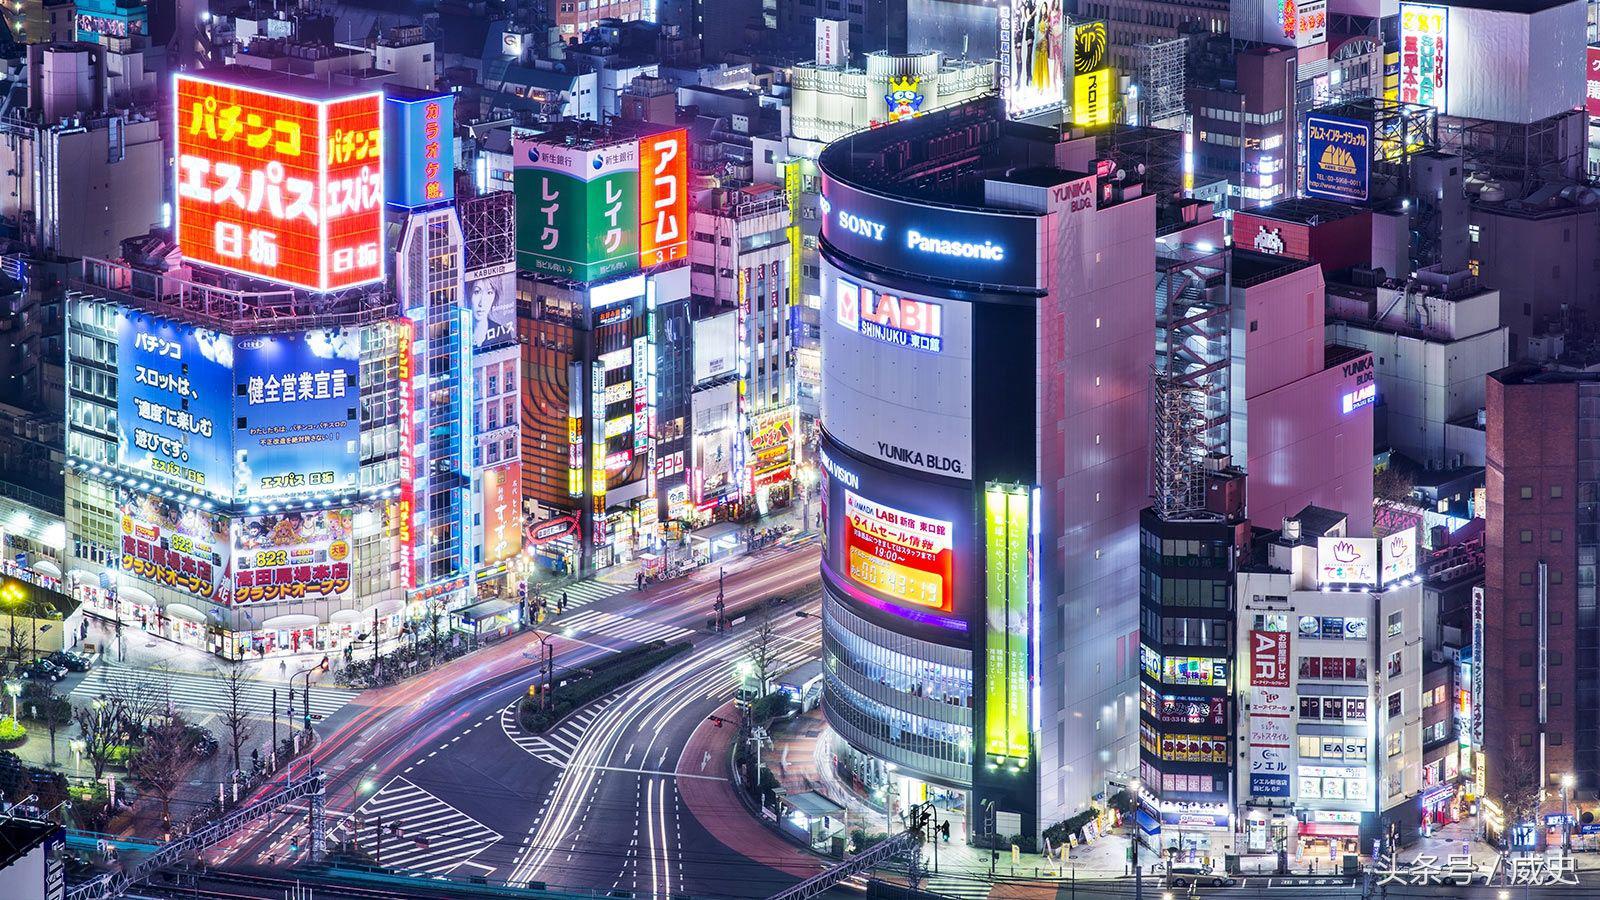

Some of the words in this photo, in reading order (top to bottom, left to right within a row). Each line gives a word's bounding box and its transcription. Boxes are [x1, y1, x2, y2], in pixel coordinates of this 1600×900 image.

[190, 95, 301, 157] パチンコ
[328, 128, 380, 165] パチンコ
[426, 102, 441, 200] カラオケ館
[542, 152, 573, 168] 新生銀行
[605, 151, 635, 166] 新生銀行
[180, 154, 320, 226] エスパス
[327, 165, 381, 219] エスパス
[654, 139, 679, 243] アコム
[1053, 180, 1092, 203] YUNIKA
[540, 177, 560, 250] レイク
[604, 179, 623, 254] レイク
[838, 211, 886, 240] SONY
[907, 230, 1004, 261] Panasonic
[861, 288, 942, 335] LABI
[135, 332, 182, 360] パチンコ
[487, 322, 514, 340] ロハス
[861, 320, 907, 345] SHINJUKU
[910, 333, 940, 352] 東口館
[135, 365, 199, 400] スロットは、
[1343, 356, 1374, 378] YUNIKA
[248, 369, 348, 406] 健全営業宣言
[135, 428, 189, 462] 遊びです。
[877, 441, 924, 466] YUNIKA
[926, 456, 964, 474] BLDG.
[152, 458, 181, 476] エスパス
[656, 456, 683, 474] アコム
[261, 474, 305, 490] エスパス
[875, 508, 898, 525] LABI
[899, 515, 916, 530] 新宿
[919, 521, 946, 536] 東口館
[122, 534, 213, 584] 高田馬場本店
[235, 562, 350, 587] 高田馬場本店
[121, 553, 214, 599] グランドオープン
[234, 579, 350, 604] グランドオープン
[1256, 633, 1276, 680] AIR
[1324, 743, 1366, 753] EAST
[1254, 761, 1287, 771] シエル
